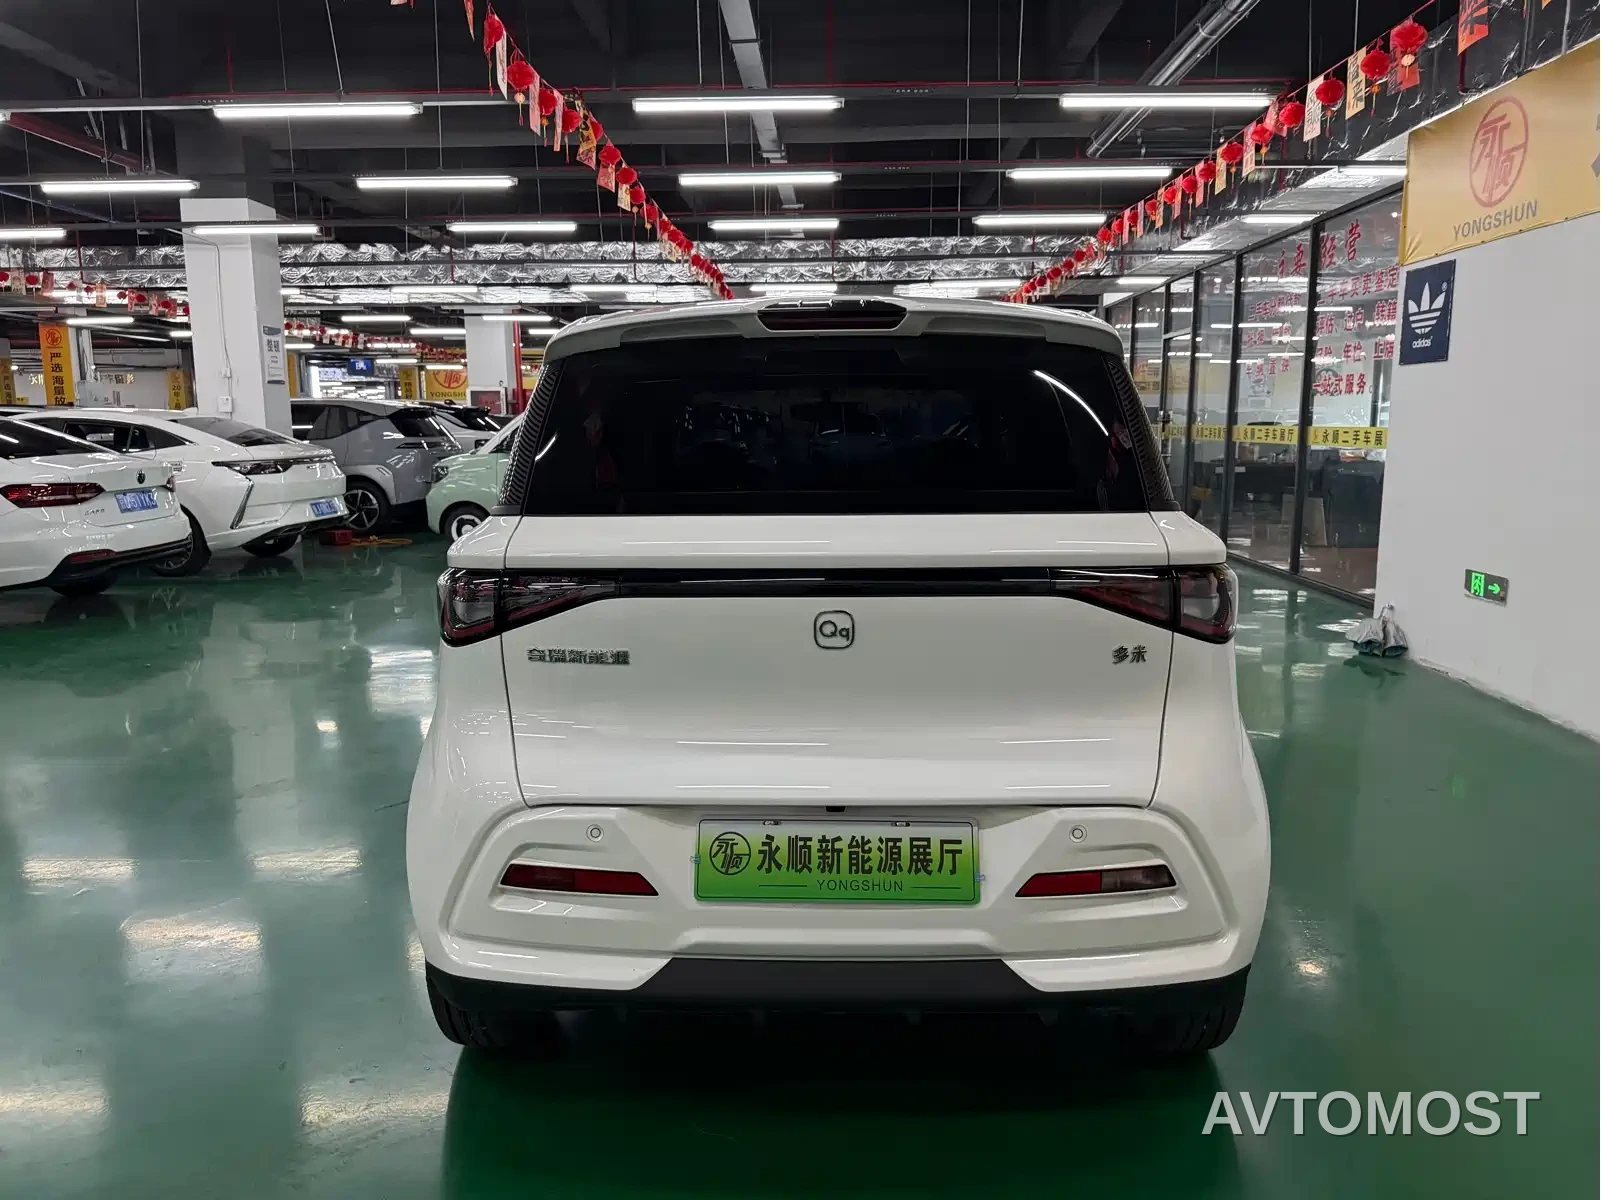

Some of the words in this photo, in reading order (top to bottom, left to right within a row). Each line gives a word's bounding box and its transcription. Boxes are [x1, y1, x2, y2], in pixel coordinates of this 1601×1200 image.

[1453, 200, 1538, 241] YONGSHUN
[1412, 338, 1433, 348] adidas
[1242, 428, 1295, 443] 永顺二手车展厅
[1321, 430, 1384, 446] 永顺二手车展
[527, 647, 630, 665] 奇瑞新能源
[1112, 645, 1147, 665] 多米
[757, 834, 963, 875] 永顺新能源展厅
[817, 879, 903, 892] YONGSHUN
